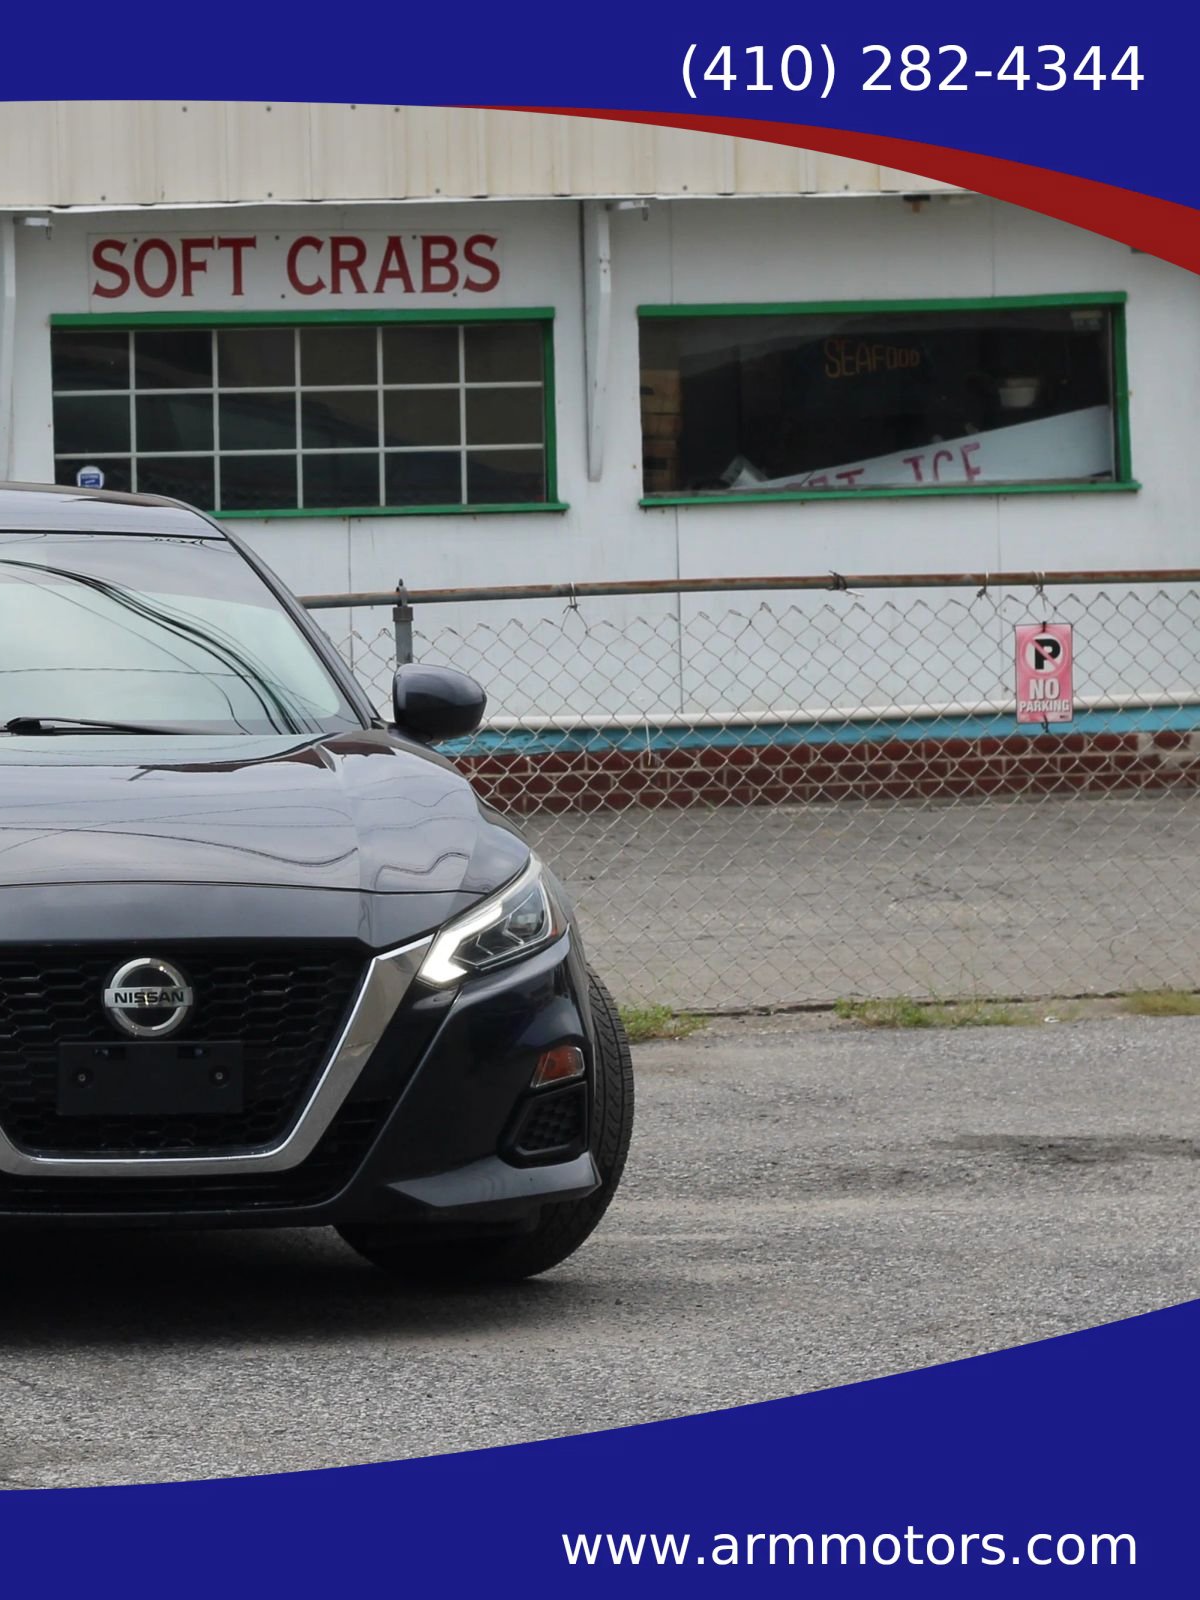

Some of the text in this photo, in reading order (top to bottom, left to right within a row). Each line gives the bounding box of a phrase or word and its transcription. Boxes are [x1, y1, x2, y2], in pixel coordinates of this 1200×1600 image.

[92, 233, 501, 299] SOFT CRABS
[1029, 677, 1061, 701] NO
[1019, 699, 1071, 713] PARKING
[114, 991, 185, 1005] NISSAN
